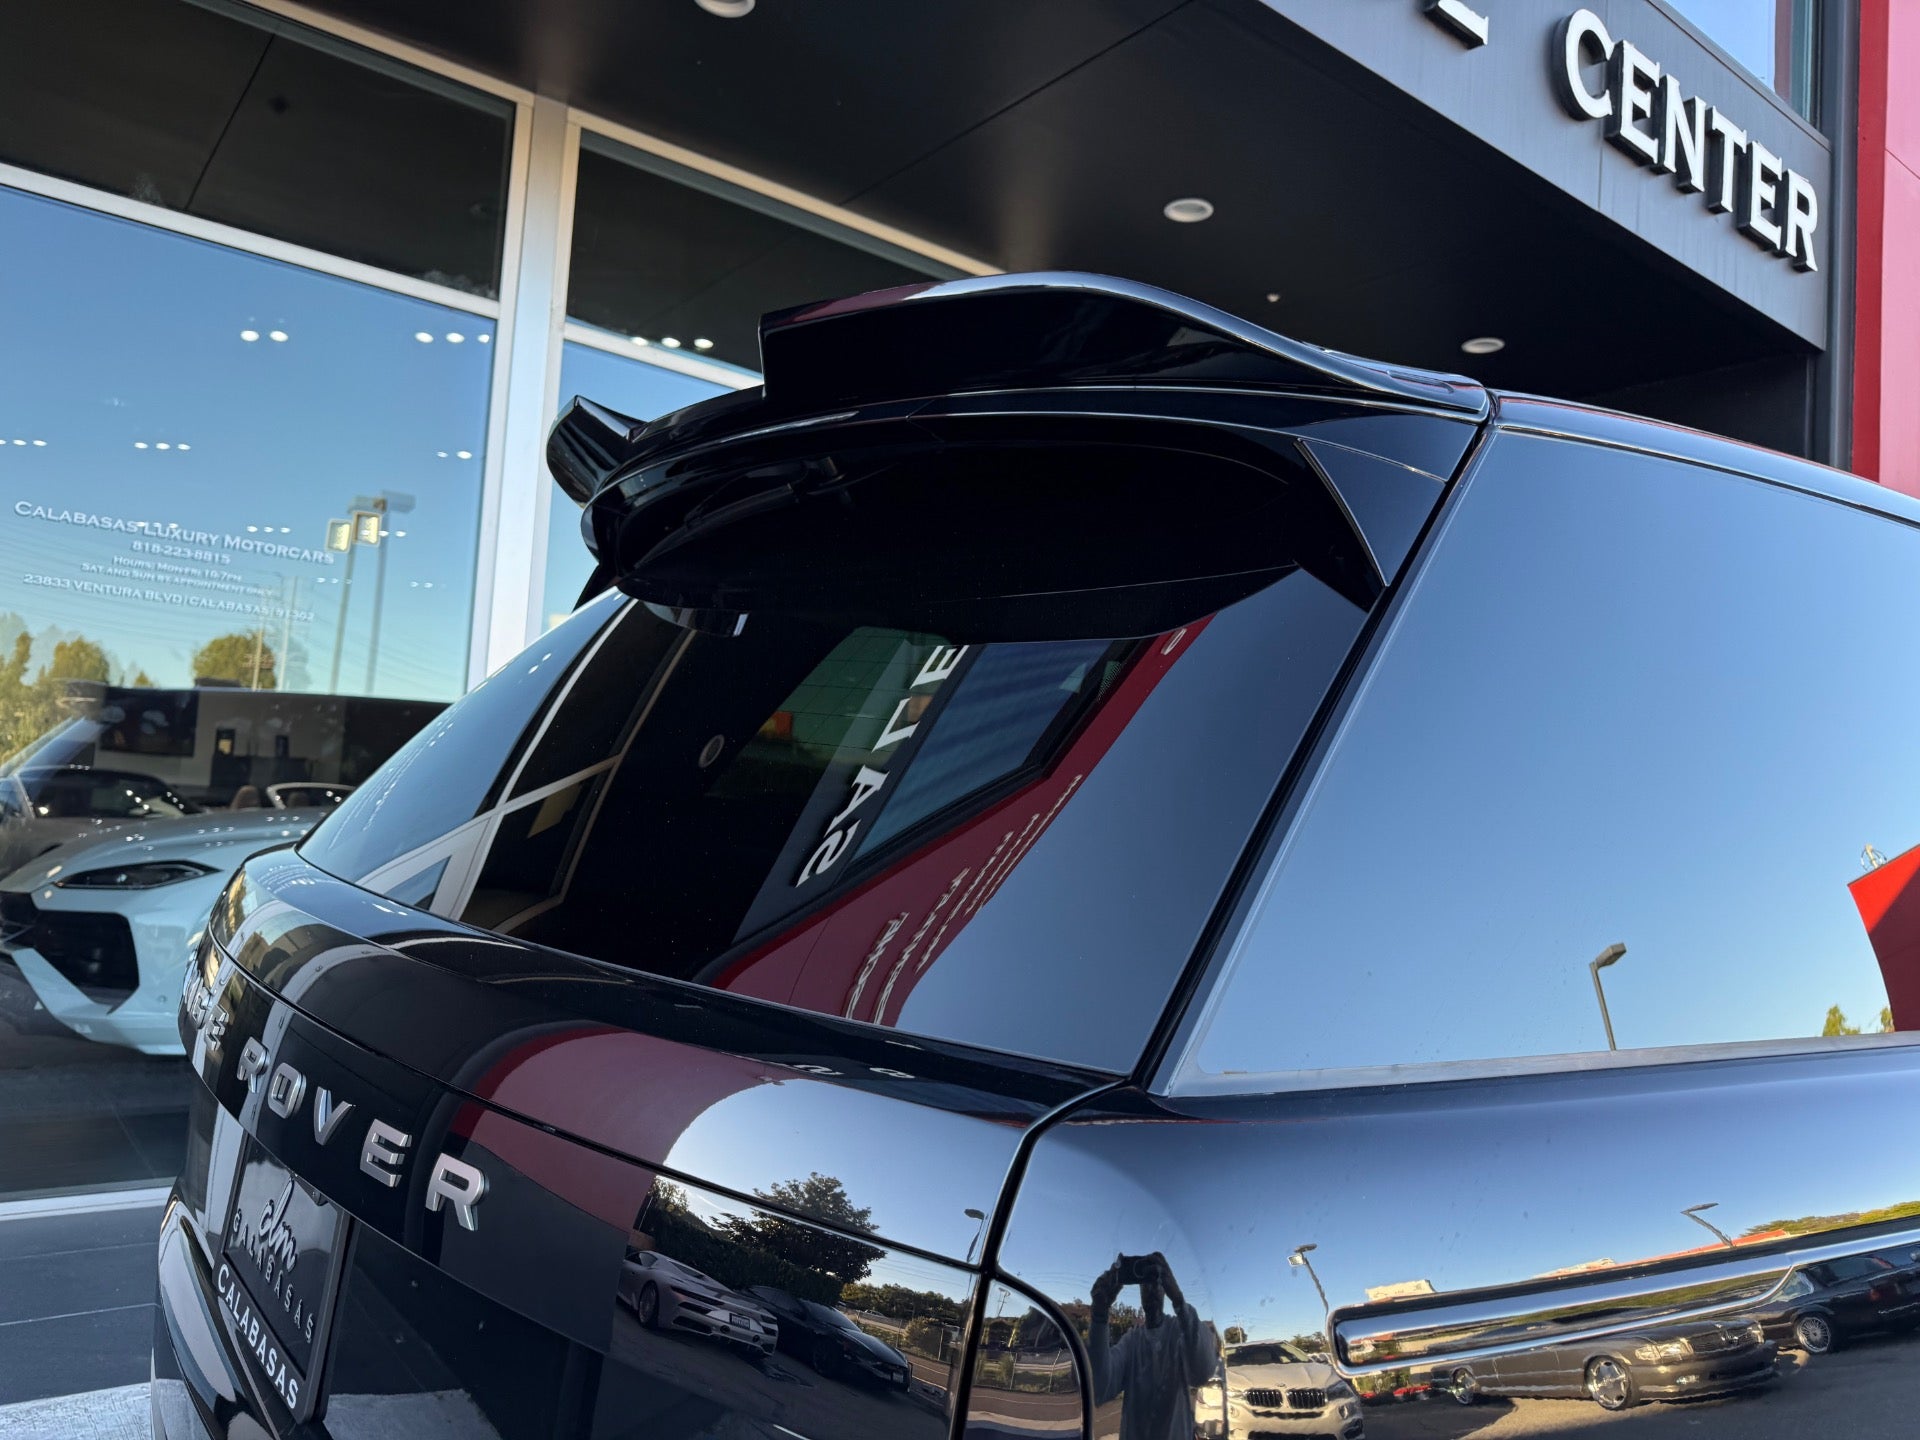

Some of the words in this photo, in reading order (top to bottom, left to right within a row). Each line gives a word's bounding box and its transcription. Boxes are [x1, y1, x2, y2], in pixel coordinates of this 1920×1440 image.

[1556, 8, 1819, 273] CENTER
[23, 573, 70, 589] 23833
[73, 580, 141, 600] VENTURA
[236, 1036, 490, 1232] ROVER
[217, 1263, 299, 1410] CALABASAS
[233, 1208, 314, 1344] CALABASAS
